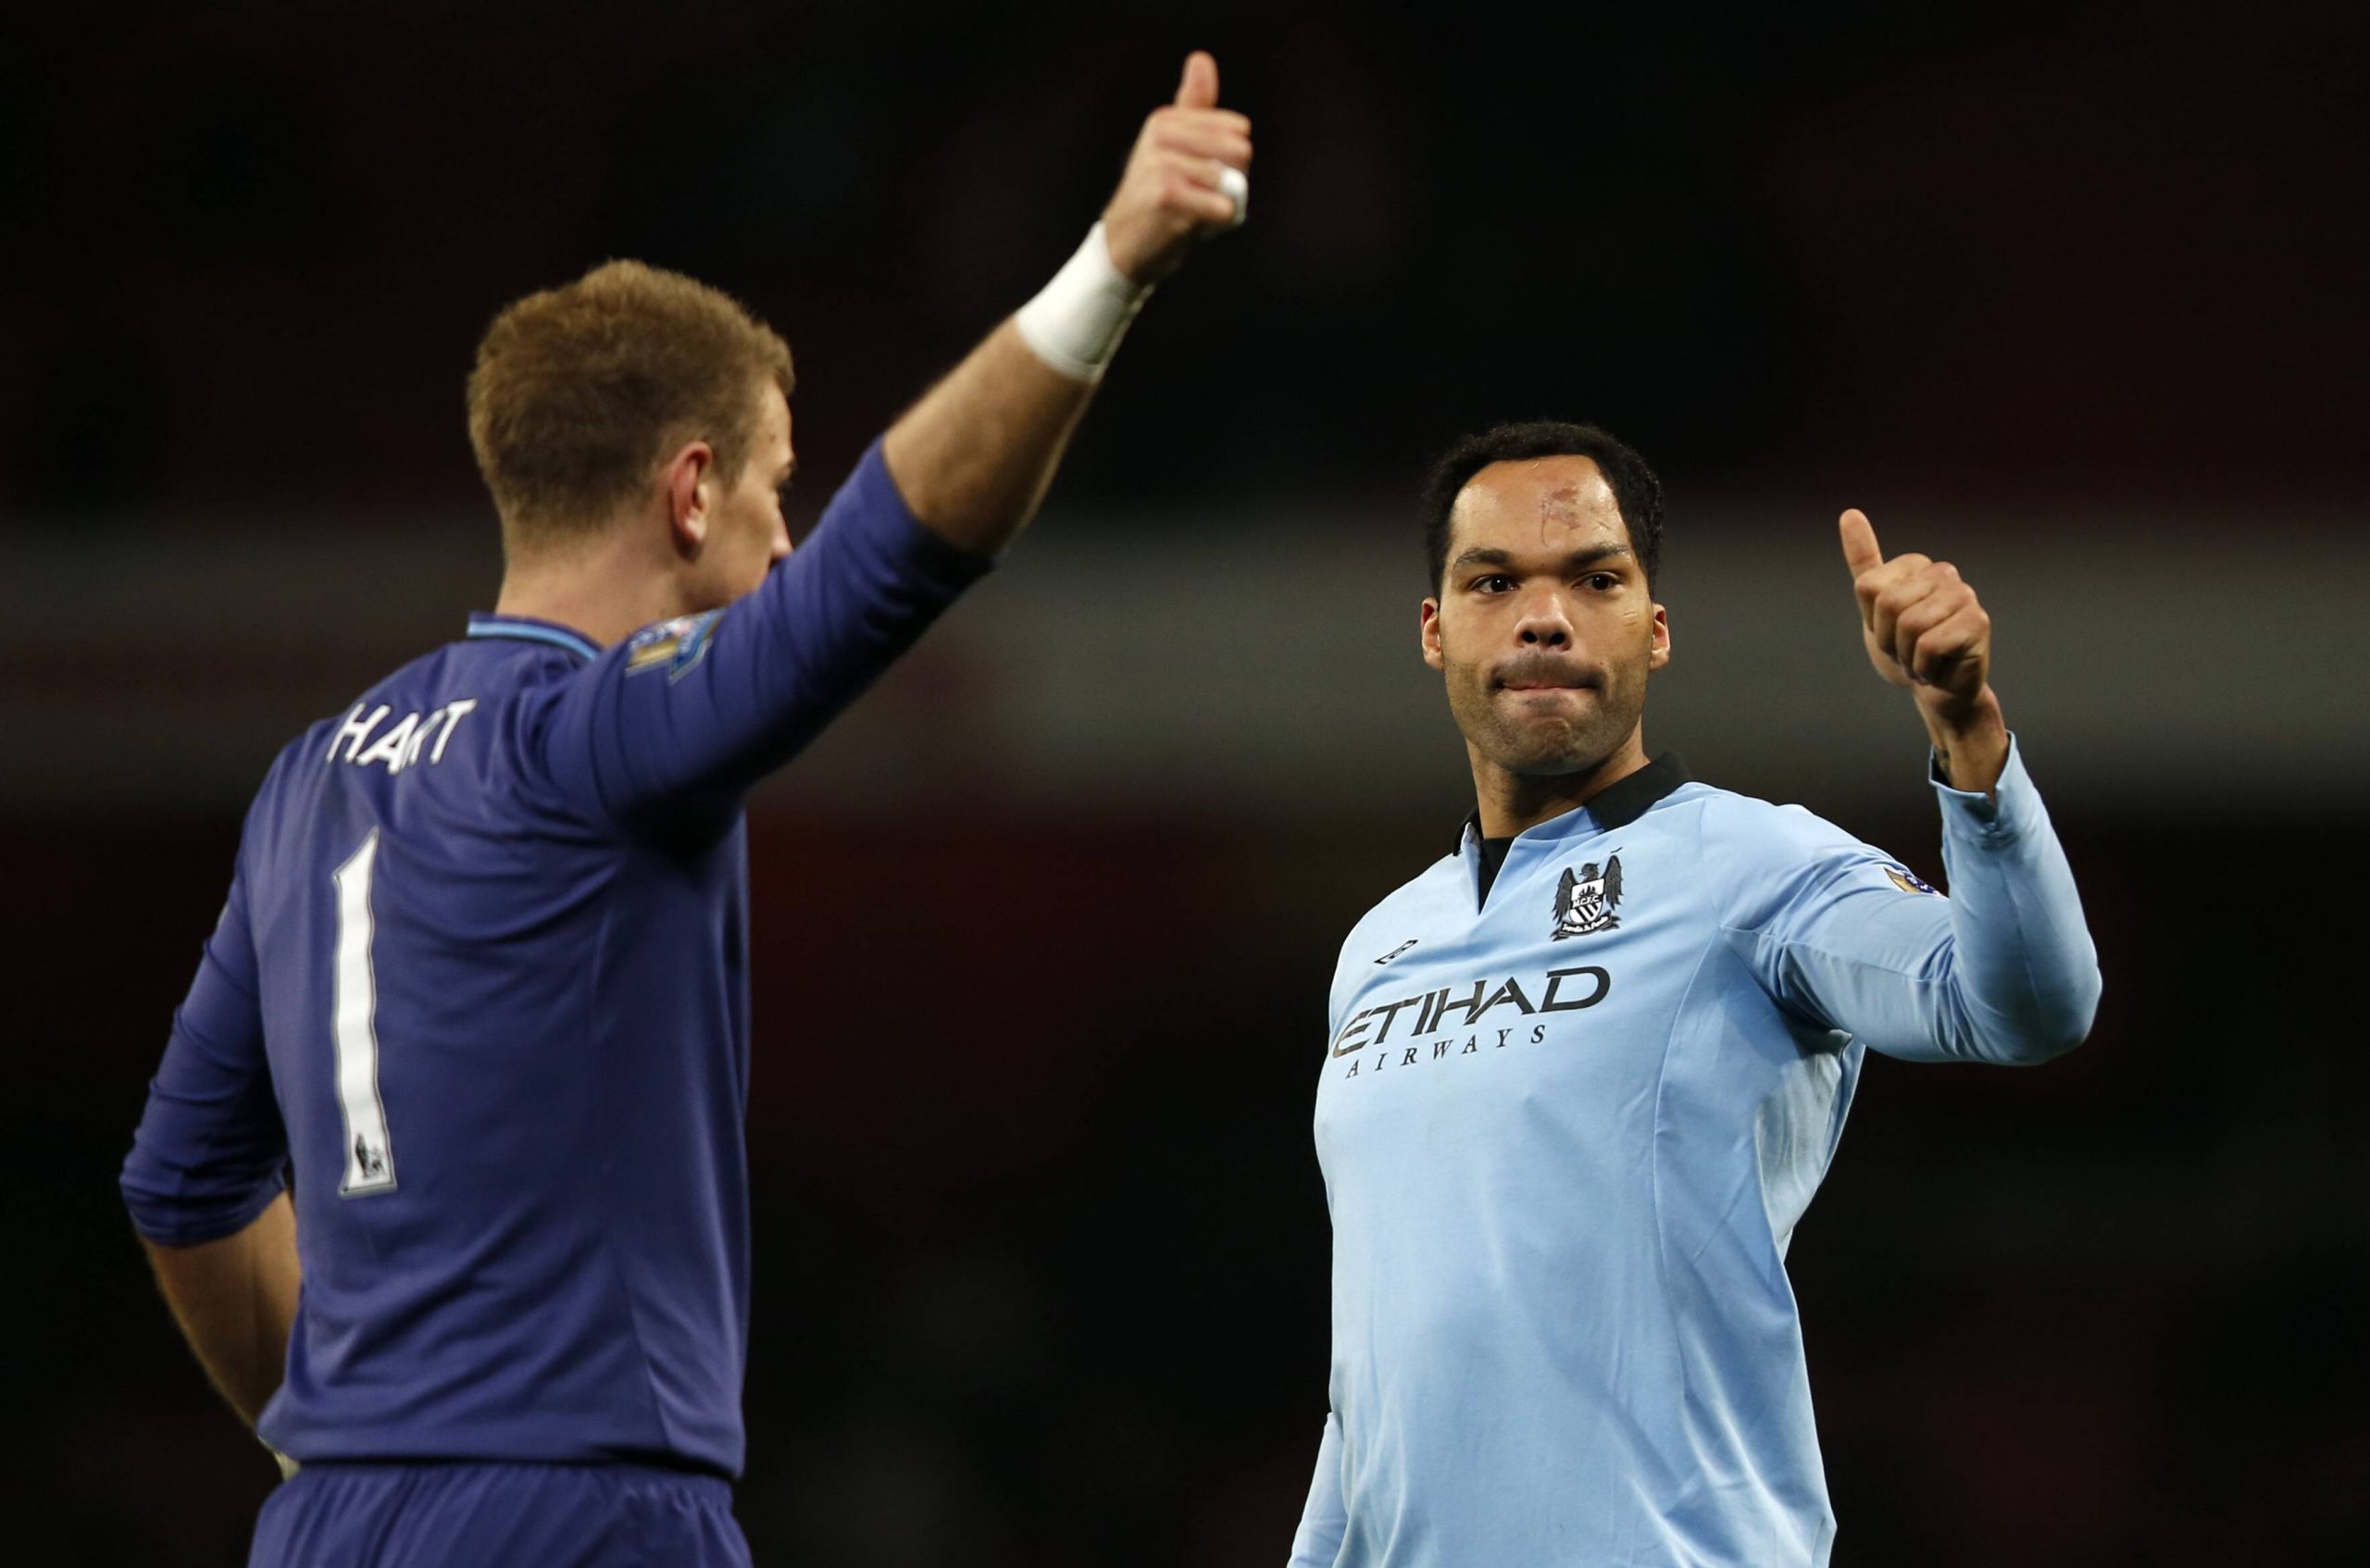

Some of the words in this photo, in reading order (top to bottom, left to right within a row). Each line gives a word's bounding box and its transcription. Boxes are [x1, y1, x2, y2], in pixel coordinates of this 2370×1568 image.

[331, 827, 398, 1197] 1
[1332, 966, 1611, 1058] ETIHAD
[1346, 1025, 1545, 1079] AIRWAYS
